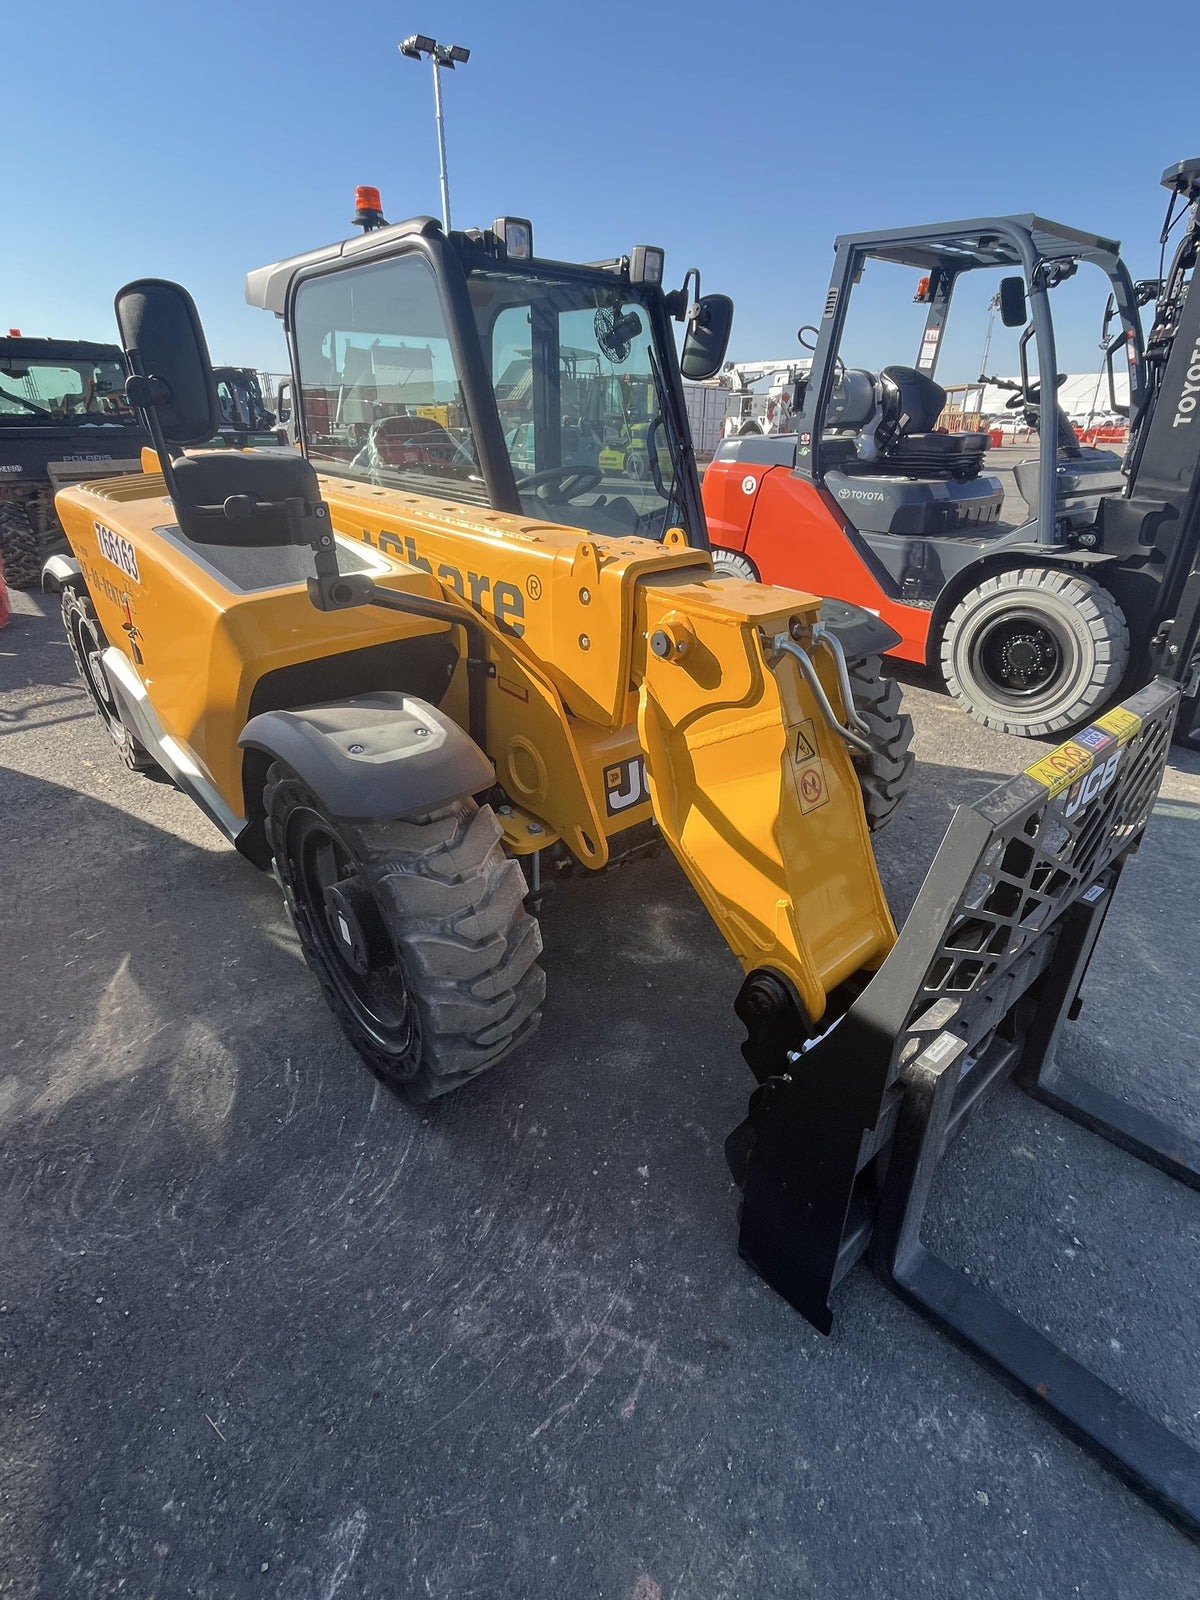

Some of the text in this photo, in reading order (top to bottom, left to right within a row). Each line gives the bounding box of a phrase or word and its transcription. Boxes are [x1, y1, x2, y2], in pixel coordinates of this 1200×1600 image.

[1173, 336, 1200, 428] TOYOT
[62, 454, 112, 463] POLARIS
[851, 490, 885, 502] TOYOTA
[94, 522, 139, 581] 766163
[1088, 732, 1105, 746] USA
[608, 760, 651, 809] J
[1065, 751, 1121, 818] JCB
